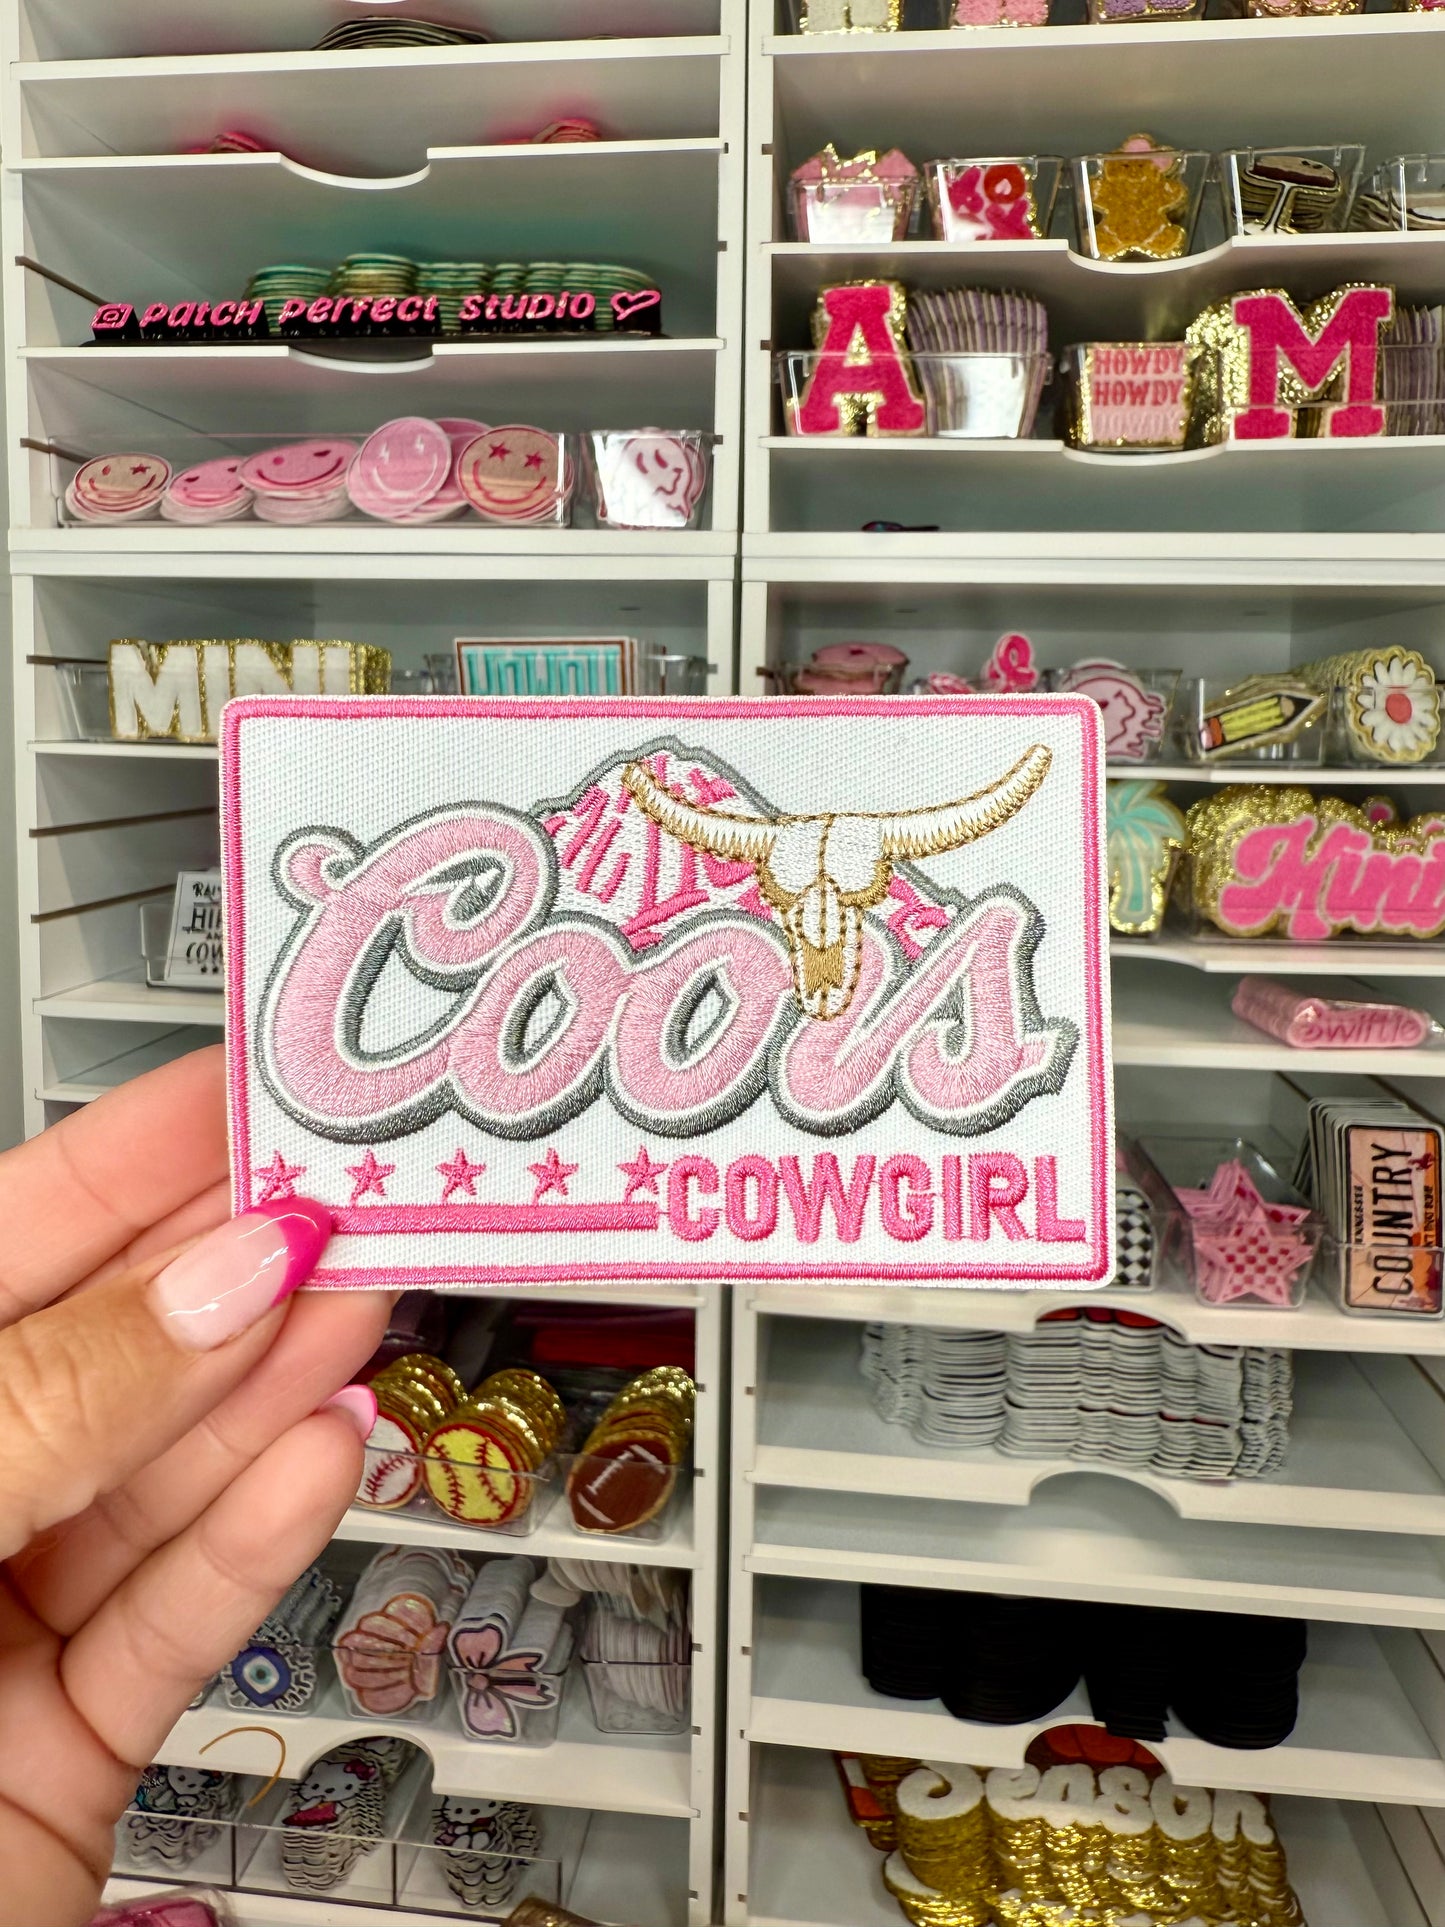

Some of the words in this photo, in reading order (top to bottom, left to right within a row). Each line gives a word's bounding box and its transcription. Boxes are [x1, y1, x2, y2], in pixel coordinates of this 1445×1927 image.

[799, 285, 925, 434] A
[1092, 379, 1184, 407] HOWDY
[1093, 348, 1184, 375] HOWDY
[1234, 290, 1391, 440] M
[258, 803, 1074, 1139] Coors
[666, 1152, 1086, 1245] COWGIRL
[1370, 1142, 1414, 1295] COUNTRY
